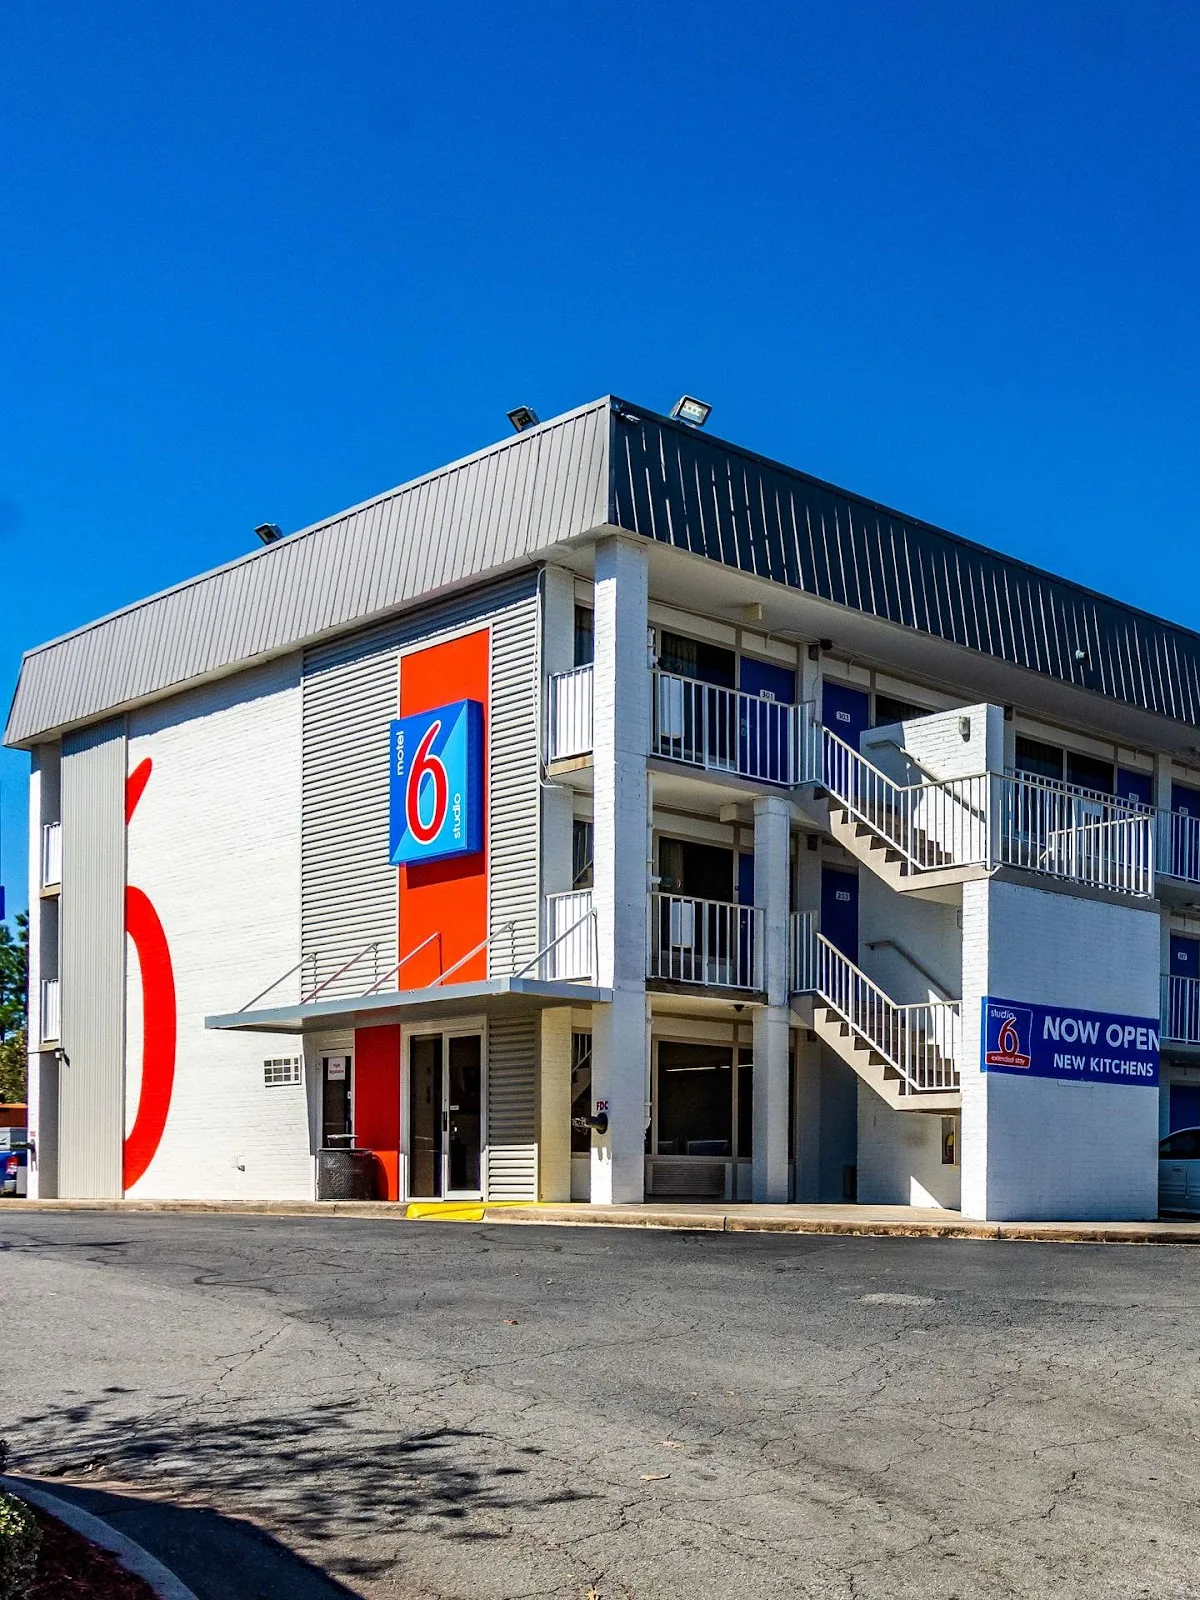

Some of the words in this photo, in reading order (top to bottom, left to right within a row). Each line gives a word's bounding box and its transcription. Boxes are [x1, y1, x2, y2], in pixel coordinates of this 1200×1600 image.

[761, 691, 774, 700] 301
[838, 712, 849, 721] 303
[396, 730, 405, 776] motel
[405, 719, 449, 845] 6
[452, 792, 461, 840] studio
[990, 1009, 1014, 1019] studio
[998, 1017, 1020, 1053] 6
[1043, 1015, 1100, 1045] NOW
[1106, 1023, 1160, 1052] OPEN
[991, 1055, 1014, 1063] extended
[1015, 1057, 1025, 1065] stay
[1053, 1053, 1086, 1071] NEW
[1090, 1057, 1154, 1077] KITCHENS
[596, 1100, 609, 1111] FDC
